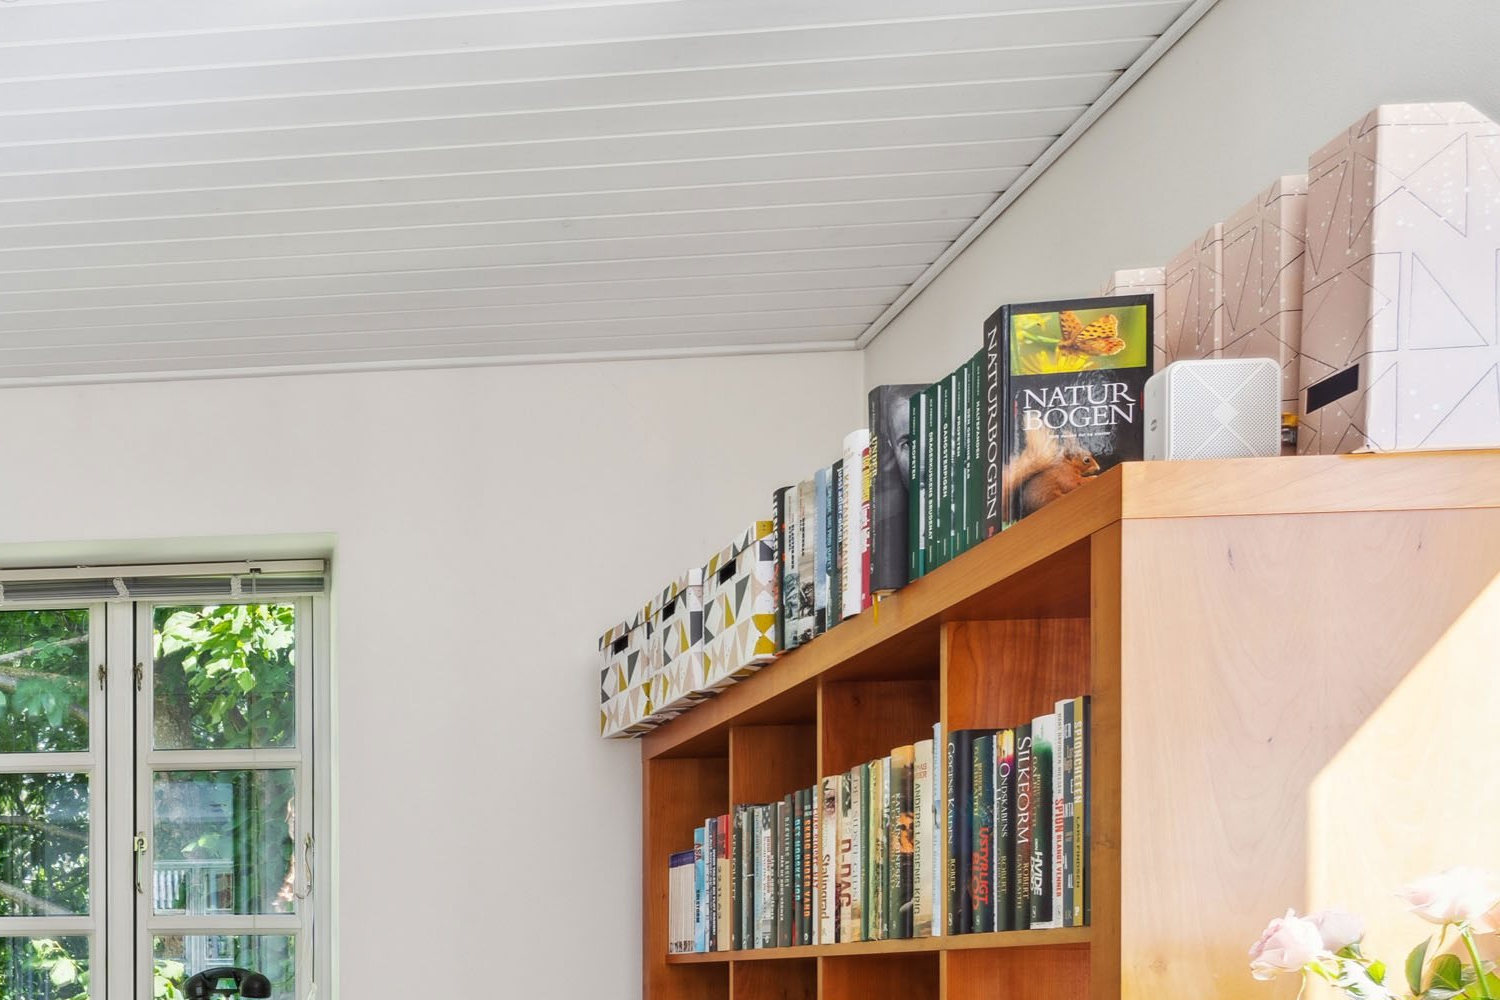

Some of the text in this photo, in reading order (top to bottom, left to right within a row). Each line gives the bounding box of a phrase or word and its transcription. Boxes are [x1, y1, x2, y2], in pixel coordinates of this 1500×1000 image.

[986, 326, 997, 520] NATURBOGEN
[1023, 382, 1136, 409] NATUR
[1023, 403, 1136, 431] BOGEN
[1017, 736, 1031, 844] SILKEORM
[1074, 721, 1082, 803] SPIONCHEFEN
[1000, 763, 1010, 837] ONDSKABENS
[1055, 799, 1064, 832] SPION
